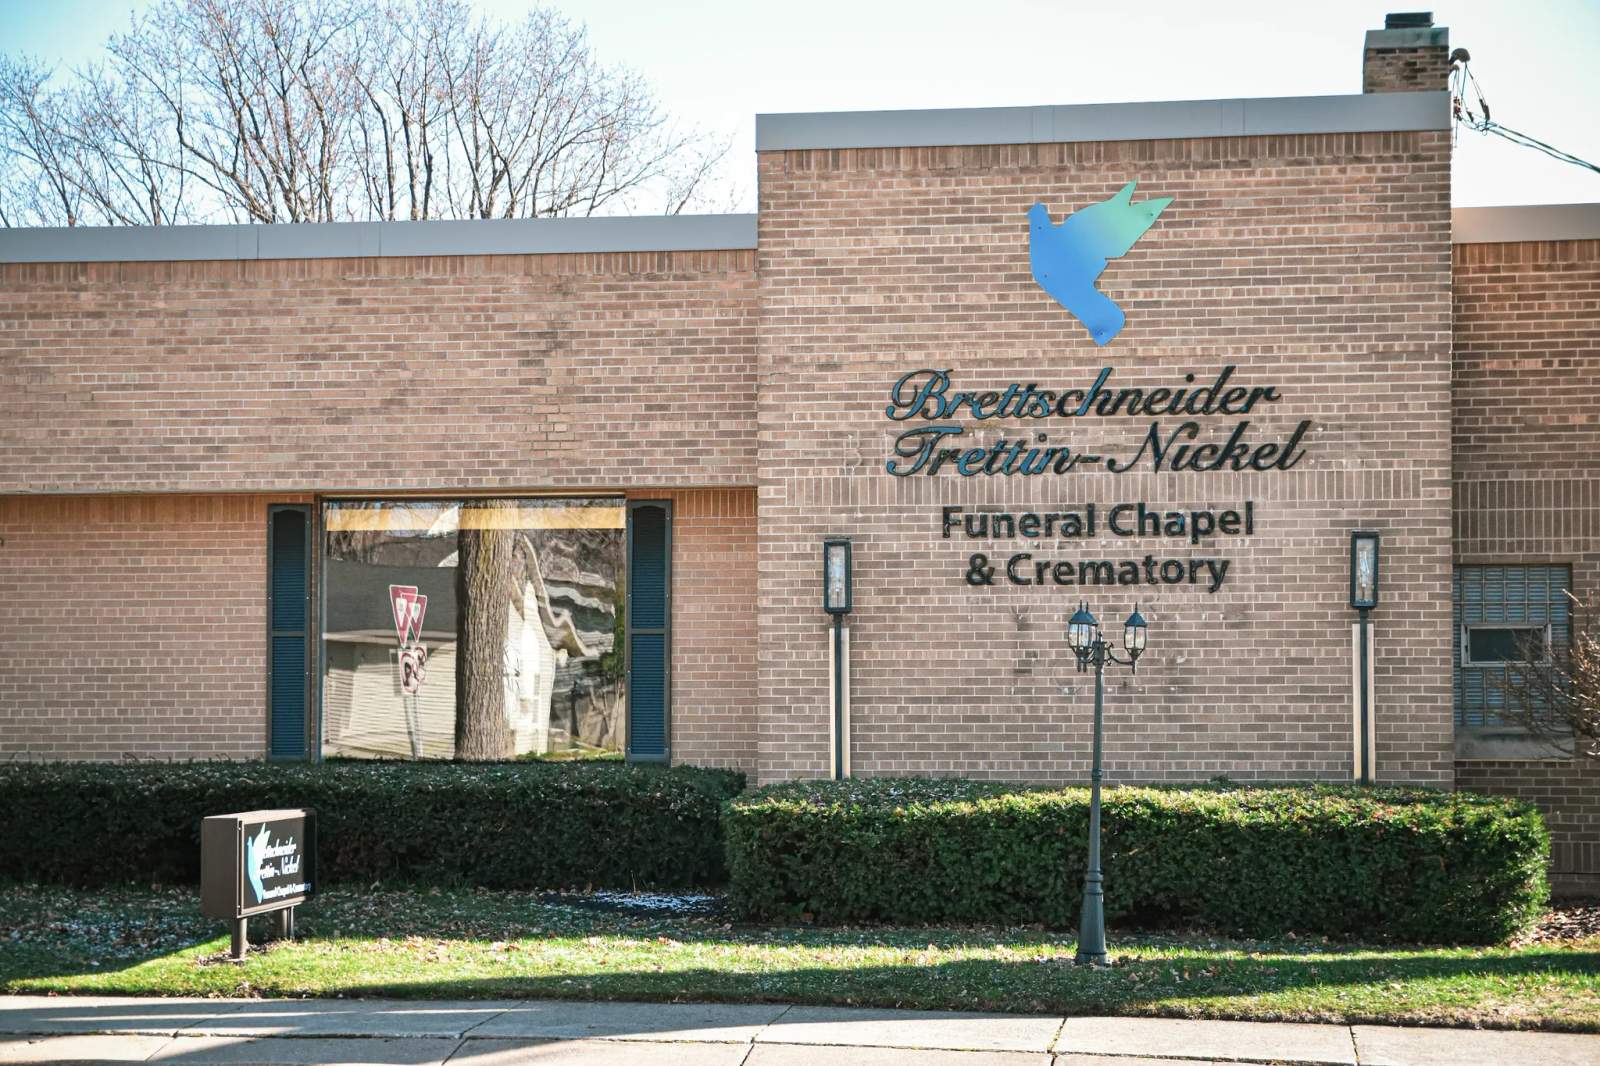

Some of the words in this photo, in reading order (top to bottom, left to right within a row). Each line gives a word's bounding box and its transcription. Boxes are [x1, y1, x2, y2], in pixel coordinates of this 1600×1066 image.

[886, 366, 1281, 420] Brettschneider
[942, 505, 1096, 539] Funeral
[1109, 501, 1254, 545] Chapel
[965, 553, 995, 586] &
[1006, 553, 1231, 593] Crematory
